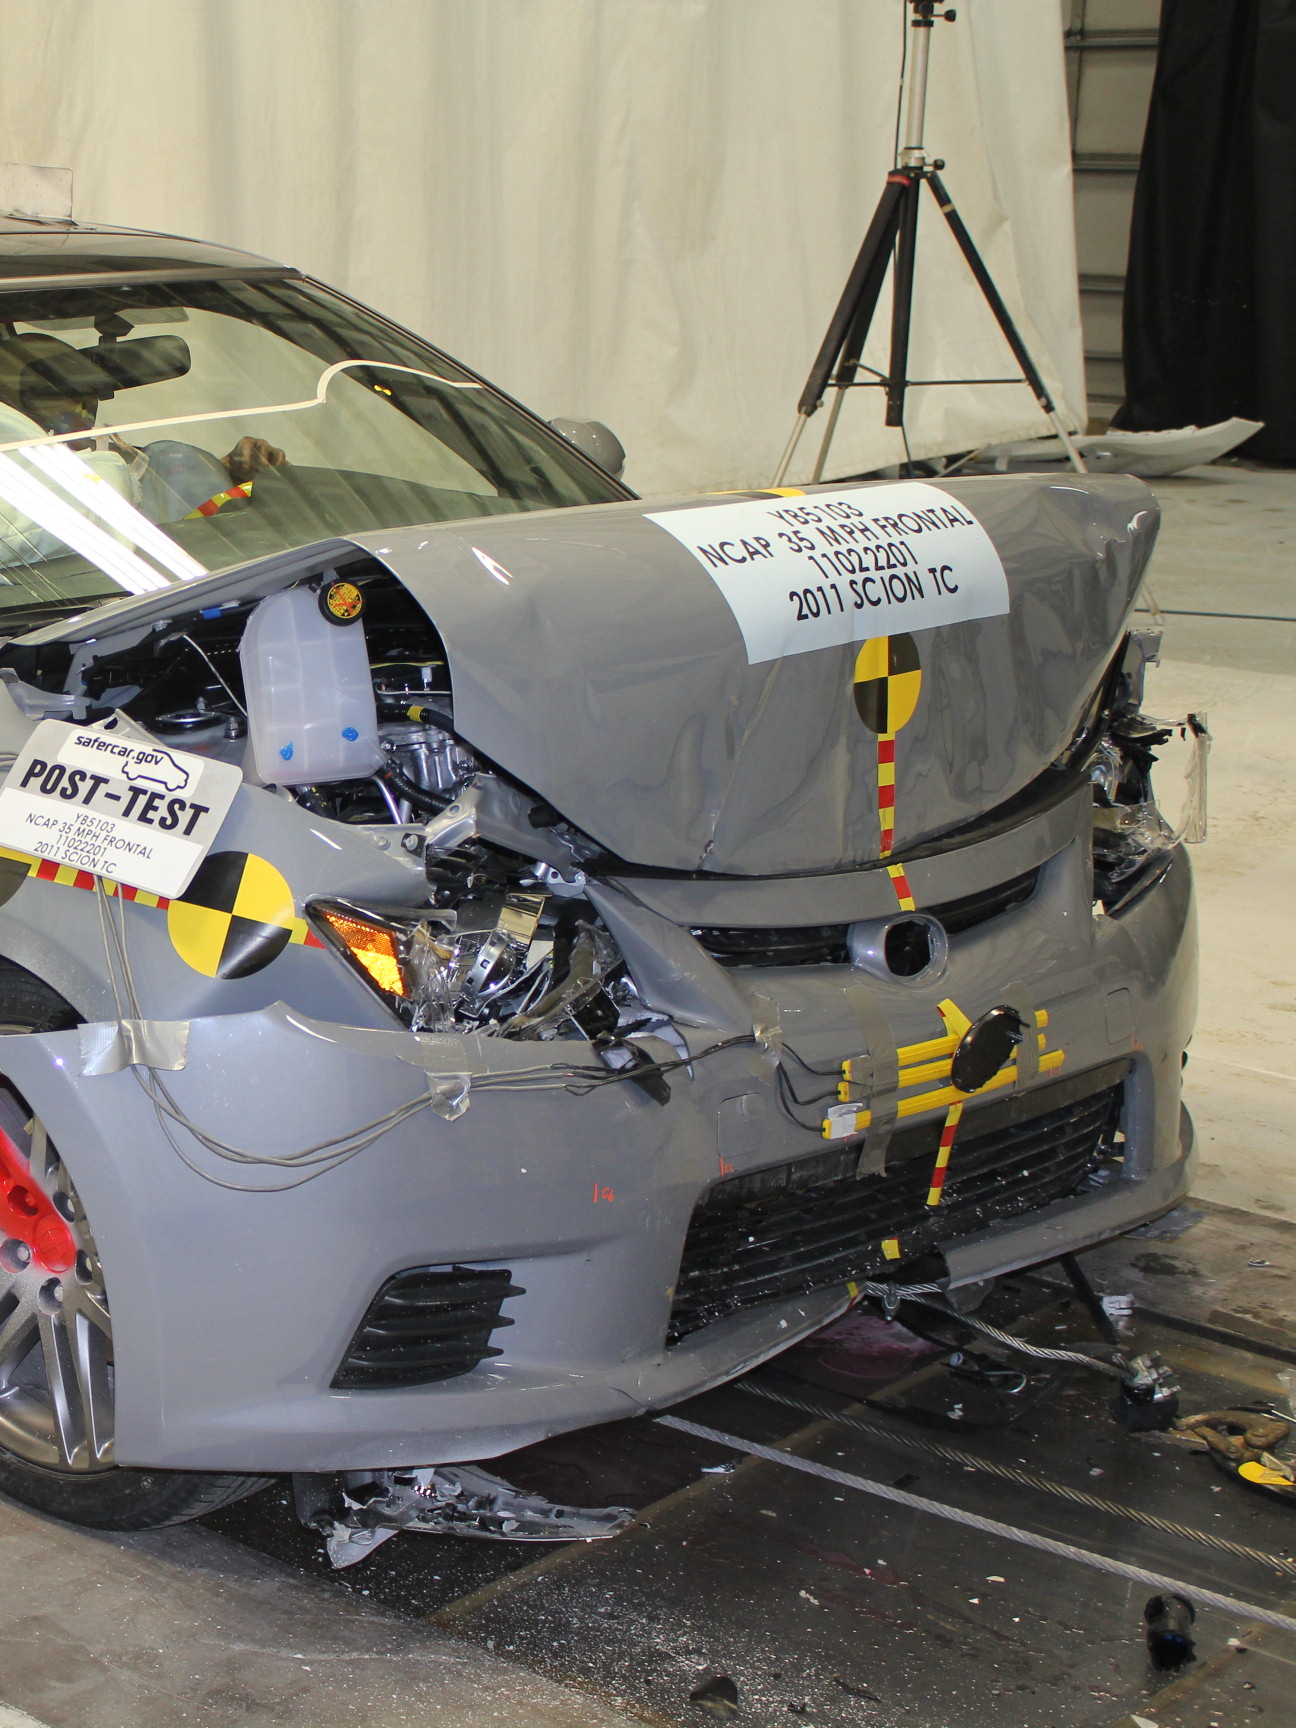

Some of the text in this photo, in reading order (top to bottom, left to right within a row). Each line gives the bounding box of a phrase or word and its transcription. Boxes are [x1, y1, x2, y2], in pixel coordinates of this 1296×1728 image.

[766, 501, 864, 528] YB5103
[697, 504, 974, 568] NCAP 35 MPH FRONTAL
[808, 540, 919, 579] 11022201
[789, 565, 959, 621] 2011 SCION TC
[74, 735, 164, 766] safercar.gov
[20, 758, 210, 836] POST-TEST
[25, 813, 153, 860] NCAP 35 MPH FRONTAL
[74, 813, 116, 833] YB5103
[34, 841, 117, 874] 2011 SCION TC
[56, 834, 107, 858] 11022201
